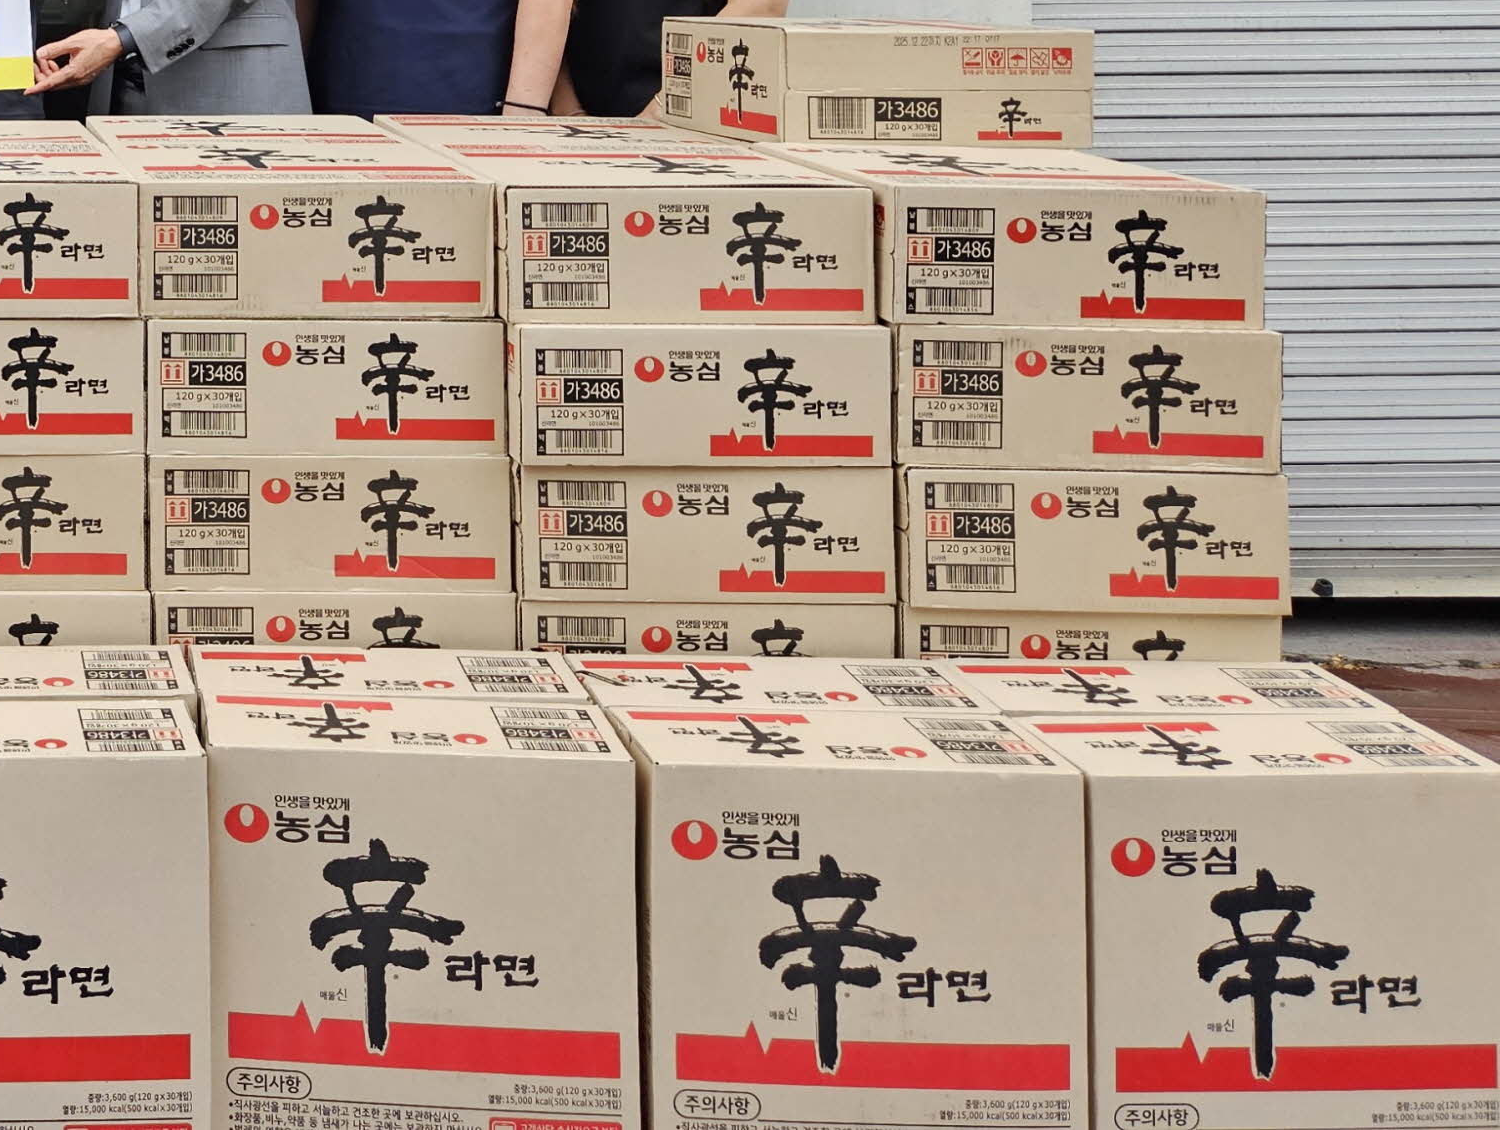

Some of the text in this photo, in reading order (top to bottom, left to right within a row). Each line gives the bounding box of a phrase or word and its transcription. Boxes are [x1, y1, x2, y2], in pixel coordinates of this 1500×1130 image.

[877, 100, 940, 120] 가3486
[884, 123, 900, 131] 120
[283, 208, 331, 228] 농심
[659, 215, 709, 235] 농심
[182, 227, 236, 247] 가3486
[1041, 221, 1091, 242] 농심
[551, 234, 607, 254] 가3486
[936, 239, 992, 260] 가3486
[65, 378, 108, 396] 라면
[362, 333, 435, 432] 辛
[1121, 345, 1200, 446] 辛
[803, 400, 848, 419] 라면
[193, 500, 247, 520] 가3486
[678, 495, 729, 515] 농심
[955, 514, 1013, 536] 가3486
[299, 620, 349, 640] 농심
[275, 795, 349, 811] 인생을 맛있게
[274, 811, 349, 843] 농심
[722, 827, 799, 860] 농심
[1162, 846, 1236, 876] 농심
[309, 838, 465, 1051] 辛
[444, 951, 535, 991] 라면
[759, 855, 917, 1070] 辛
[1198, 869, 1349, 1078] 辛
[21, 964, 113, 1004] 라면
[897, 968, 991, 1007] 라면
[1331, 975, 1421, 1014] 라면
[236, 1074, 301, 1094] 주의사항
[282, 1102, 309, 1115] 피하고
[313, 1103, 349, 1117] 서늘하고
[353, 1105, 380, 1118] 건조한
[383, 1107, 401, 1120] 곳에
[684, 1094, 750, 1114] 주의사항
[1125, 1109, 1190, 1129] 주의사항
